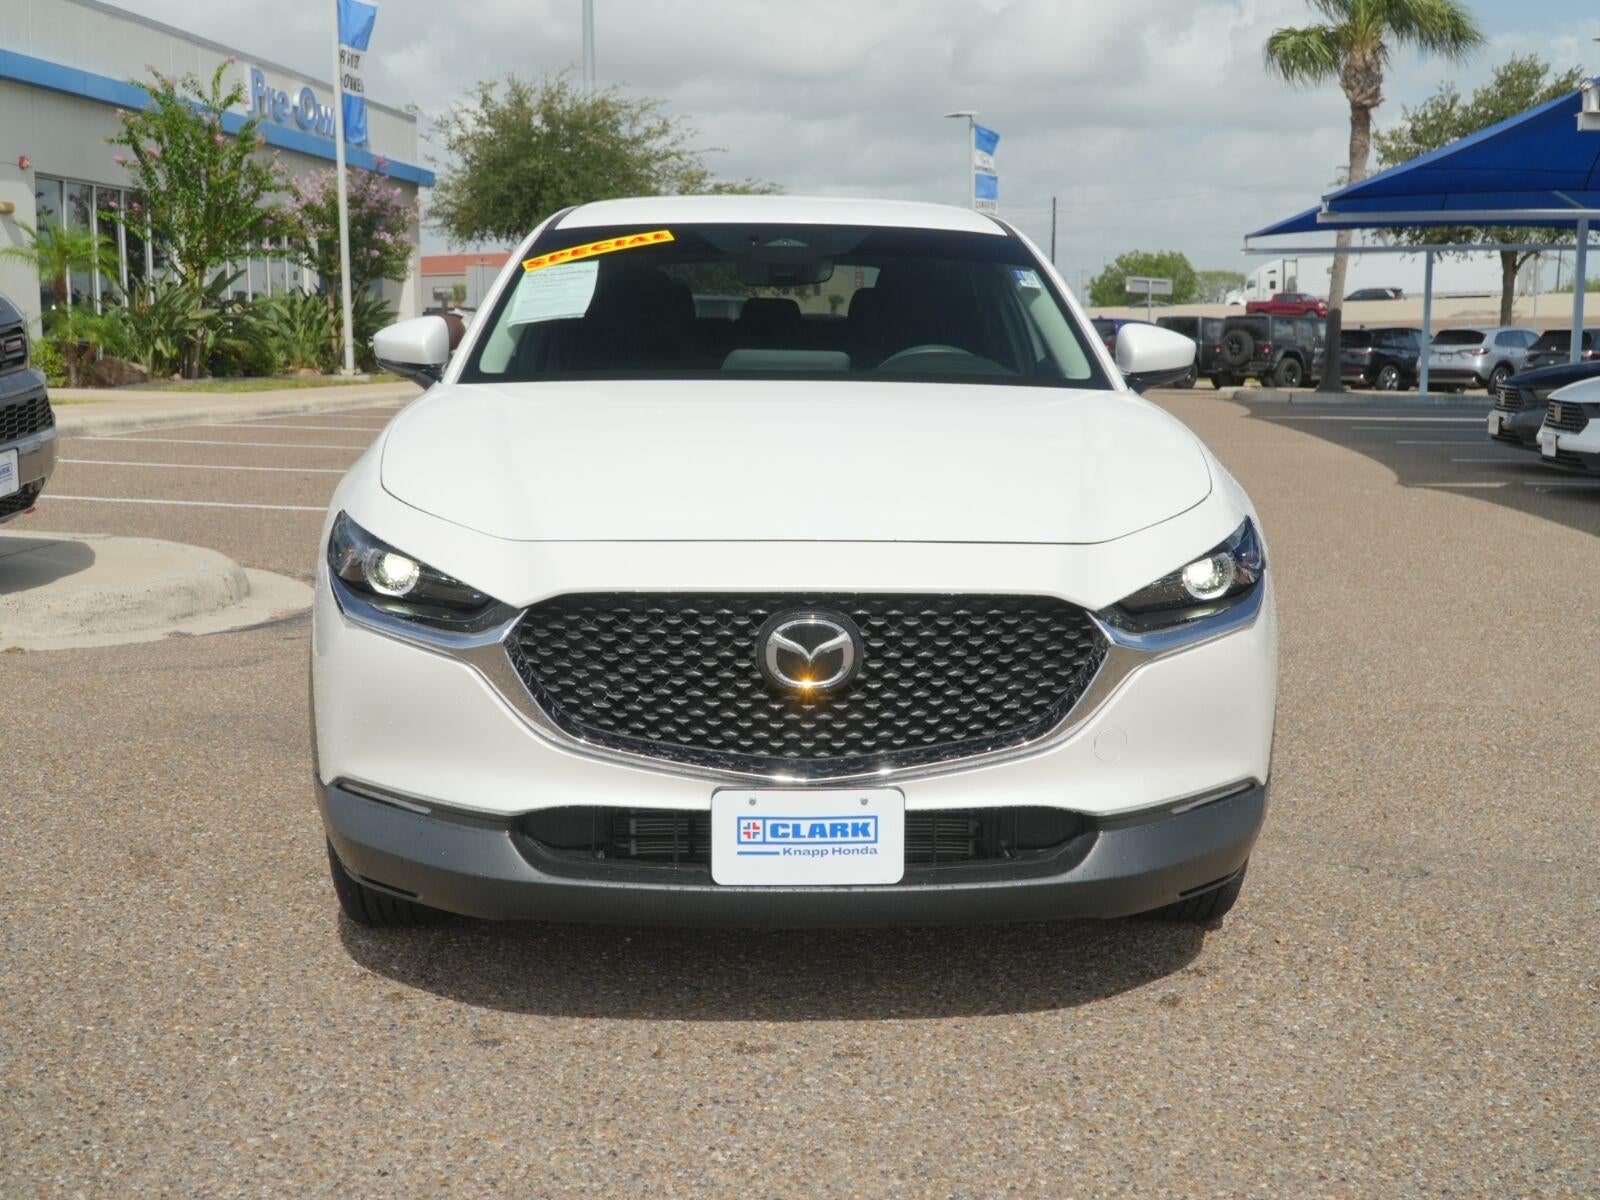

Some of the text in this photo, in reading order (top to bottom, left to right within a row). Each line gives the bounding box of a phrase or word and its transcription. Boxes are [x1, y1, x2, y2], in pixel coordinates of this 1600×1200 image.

[250, 67, 336, 138] Pre-Ow
[527, 232, 667, 268] SPECIAL
[770, 822, 871, 839] CLARK
[783, 846, 878, 857] Knapp Honda
